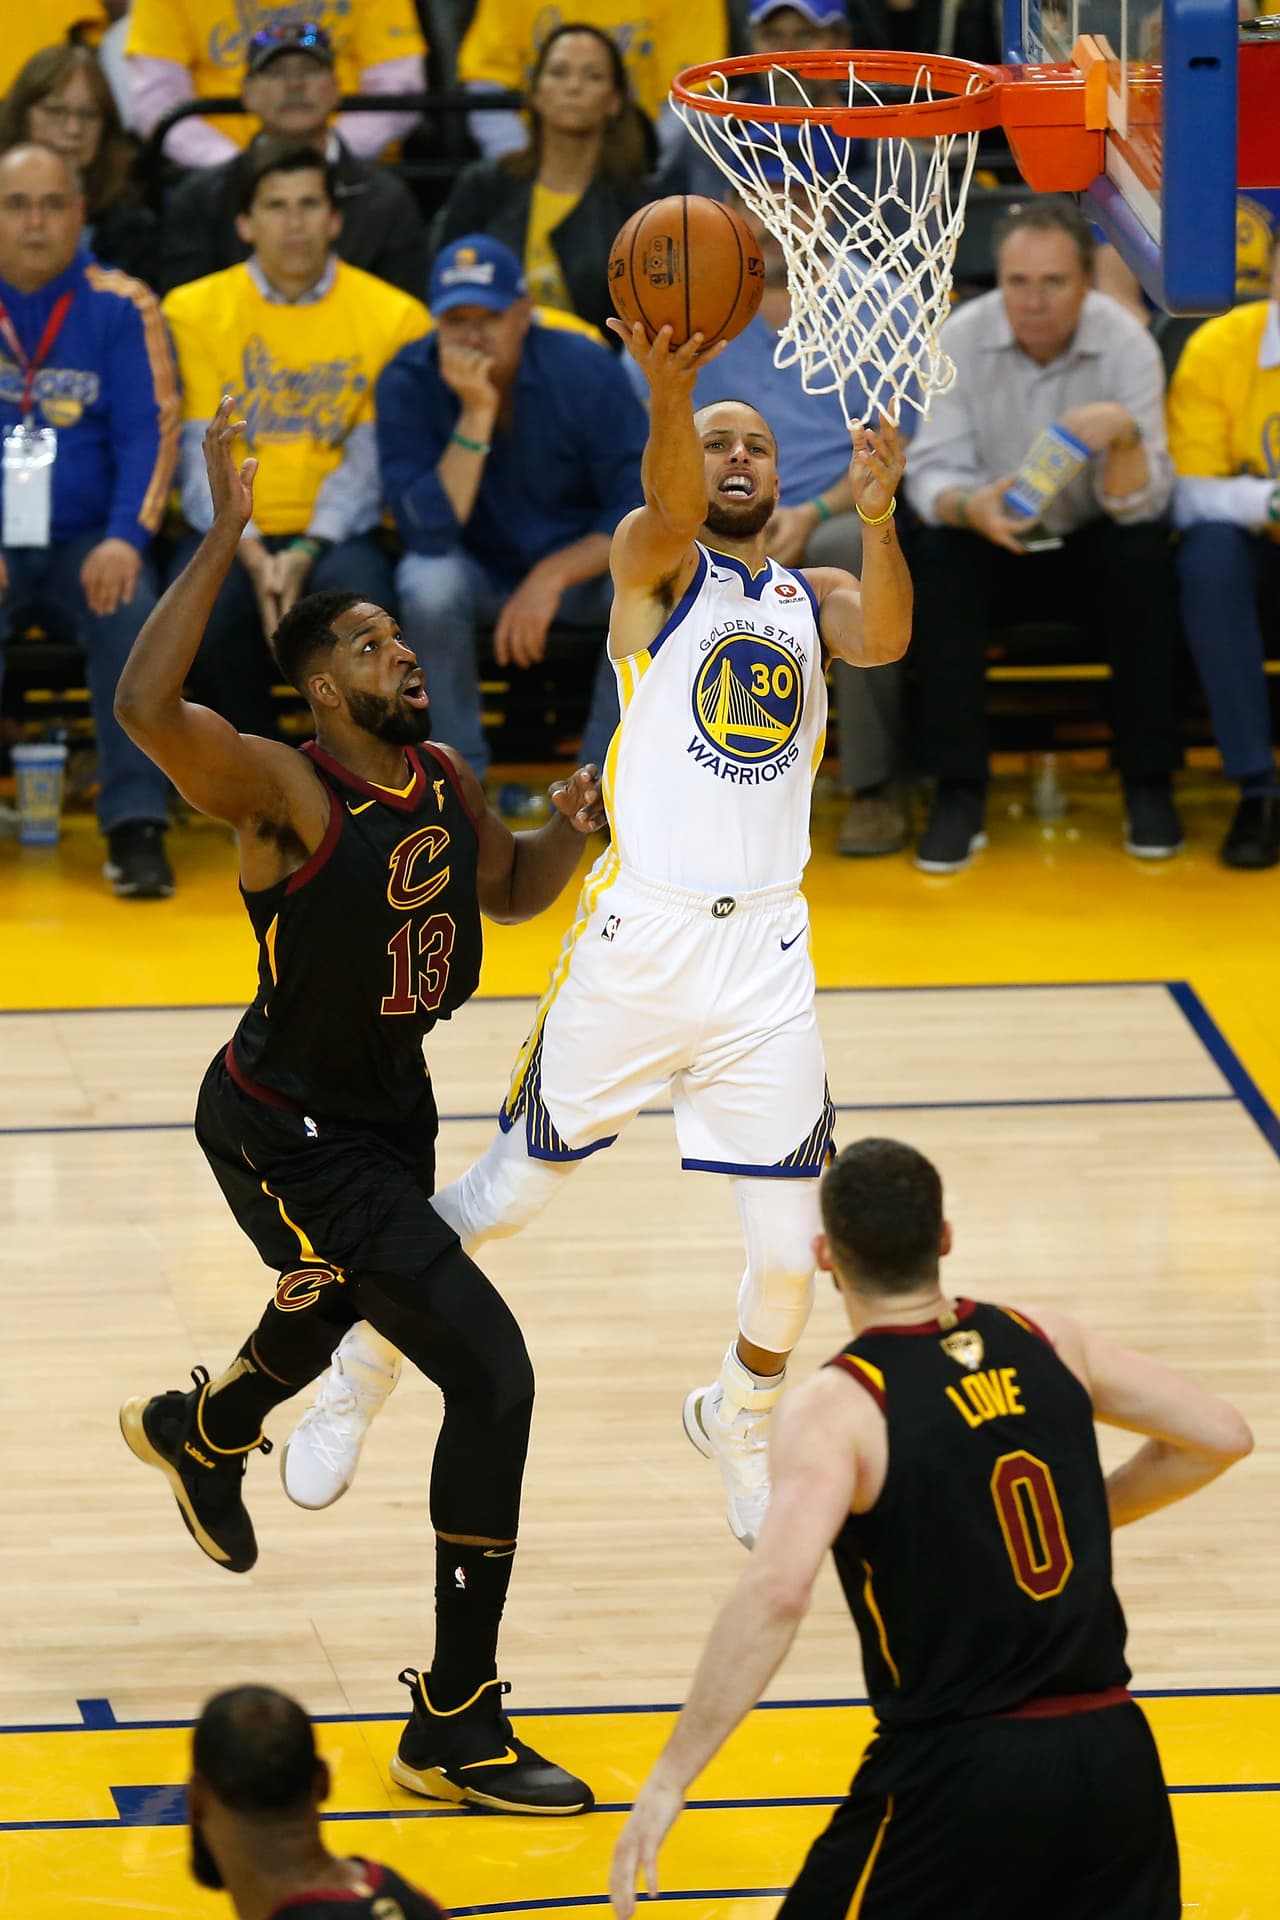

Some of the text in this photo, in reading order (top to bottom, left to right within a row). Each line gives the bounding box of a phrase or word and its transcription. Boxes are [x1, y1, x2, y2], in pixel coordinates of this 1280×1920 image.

[700, 619, 808, 667] GOLDEN STATE
[750, 663, 794, 699] 30
[686, 735, 800, 785] WARRIORS
[387, 825, 451, 910] C
[380, 912, 456, 1015] 13
[274, 1268, 335, 1312] C
[945, 1367, 1026, 1429] LOVE
[990, 1449, 1074, 1601] 0
